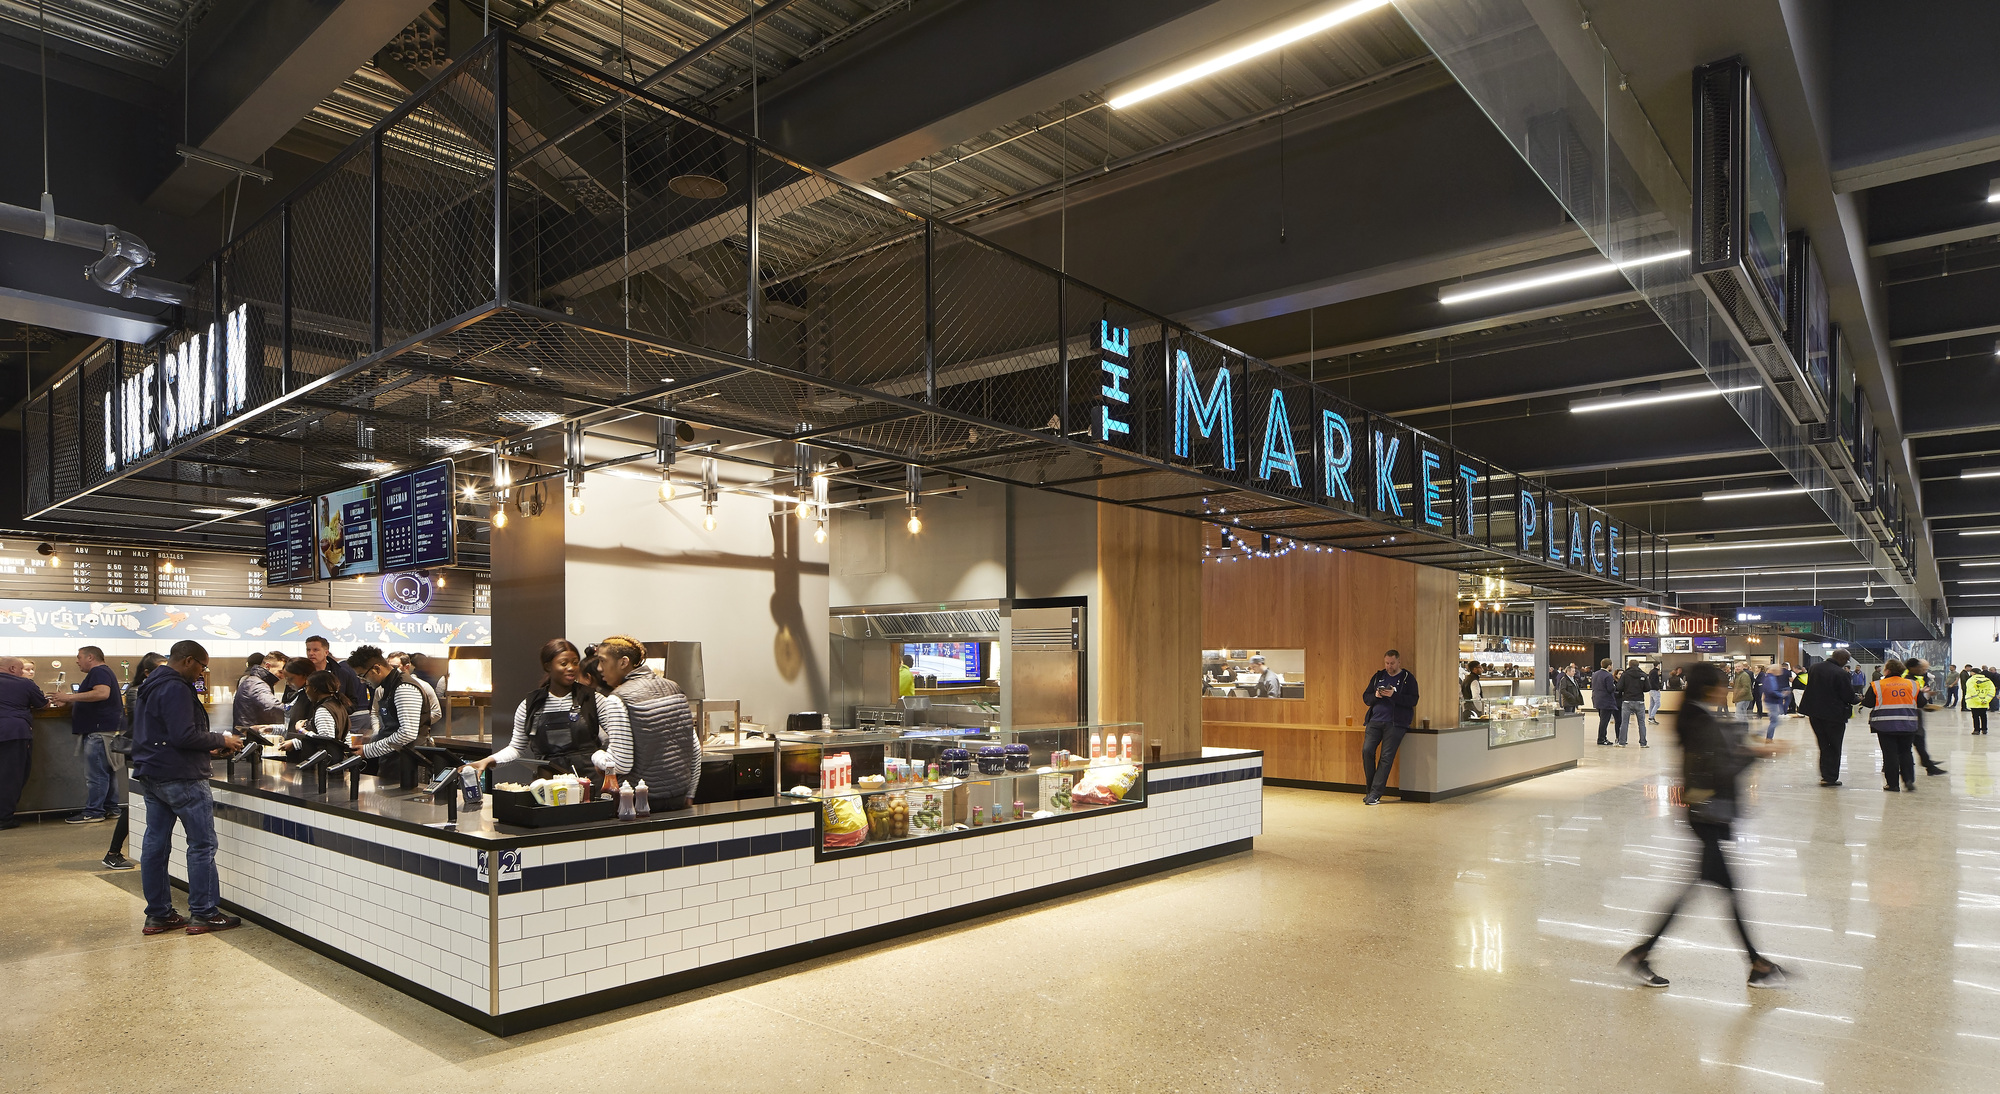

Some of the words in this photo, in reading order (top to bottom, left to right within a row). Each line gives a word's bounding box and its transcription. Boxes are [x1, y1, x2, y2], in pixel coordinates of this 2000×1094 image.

[105, 303, 248, 473] LINESMAN
[1101, 319, 1130, 441] THE
[1174, 349, 1478, 536] MARKET
[1521, 489, 1619, 576] PLACE
[352, 546, 364, 560] 7.95
[1624, 619, 1658, 635] NAAN
[1670, 617, 1719, 634] NOODLE
[1891, 688, 1906, 697] 06
